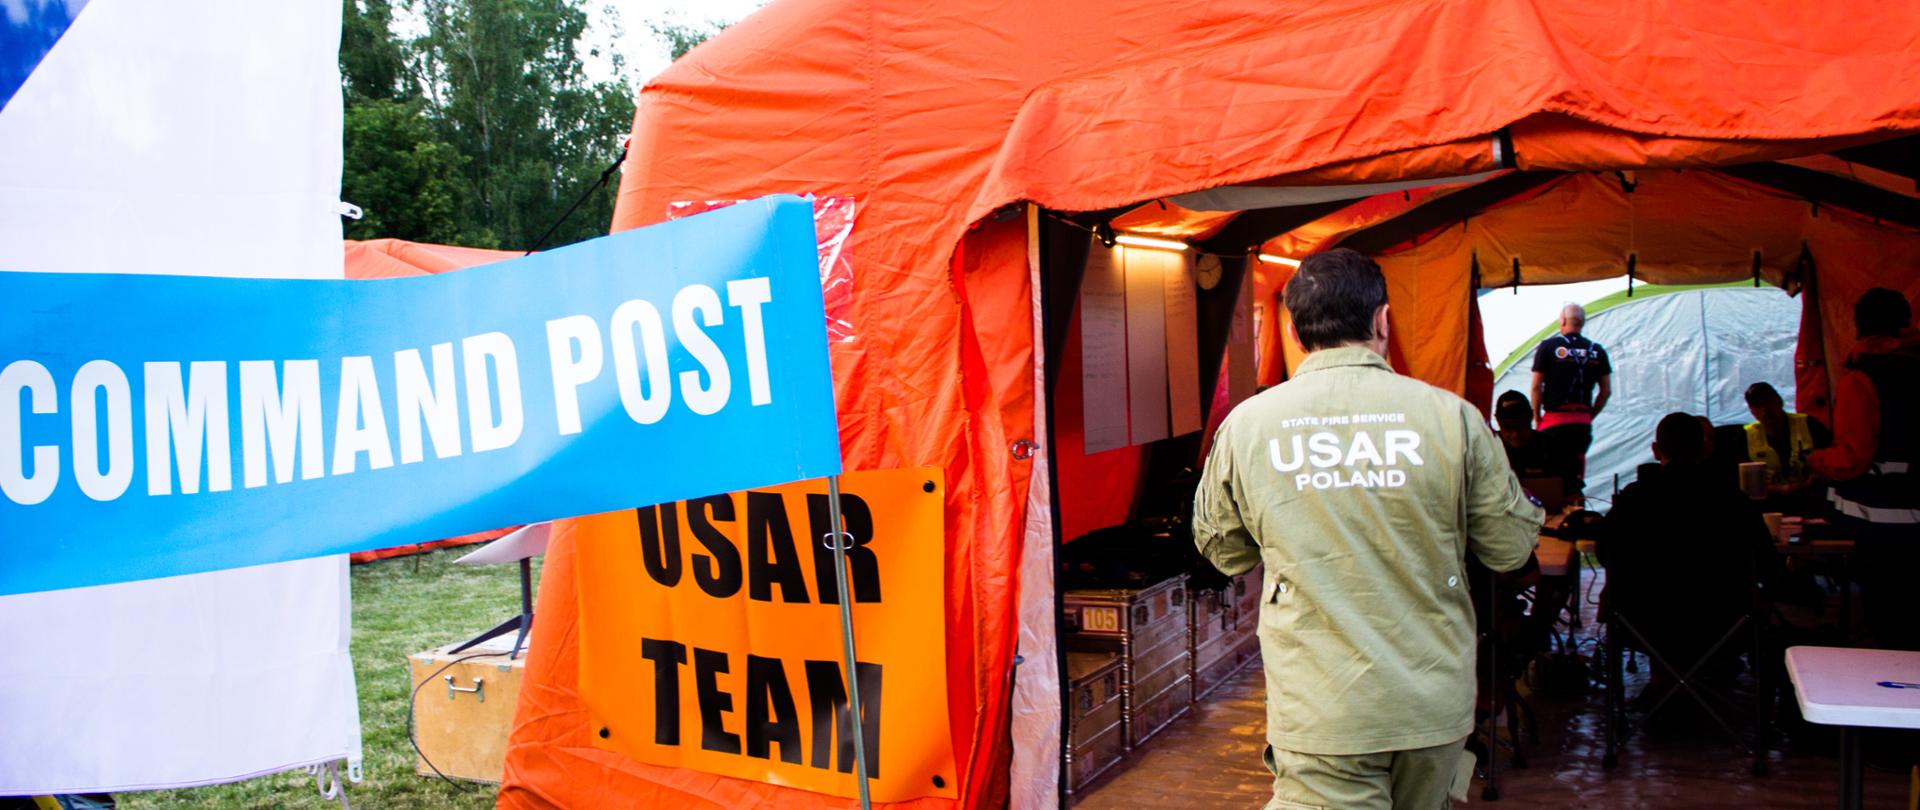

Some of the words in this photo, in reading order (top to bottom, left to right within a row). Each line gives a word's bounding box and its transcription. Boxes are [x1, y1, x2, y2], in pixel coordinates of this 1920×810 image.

[0, 332, 525, 505] COMMAND
[546, 277, 772, 435] POST
[1281, 417, 1320, 428] STATE
[1322, 416, 1349, 426] FIRE
[1352, 413, 1405, 424] SERVICE
[1269, 430, 1424, 472] USAR
[1295, 470, 1406, 491] POLAND
[636, 491, 881, 604] USAR
[1086, 608, 1115, 629] 105
[641, 638, 883, 779] TEAM
